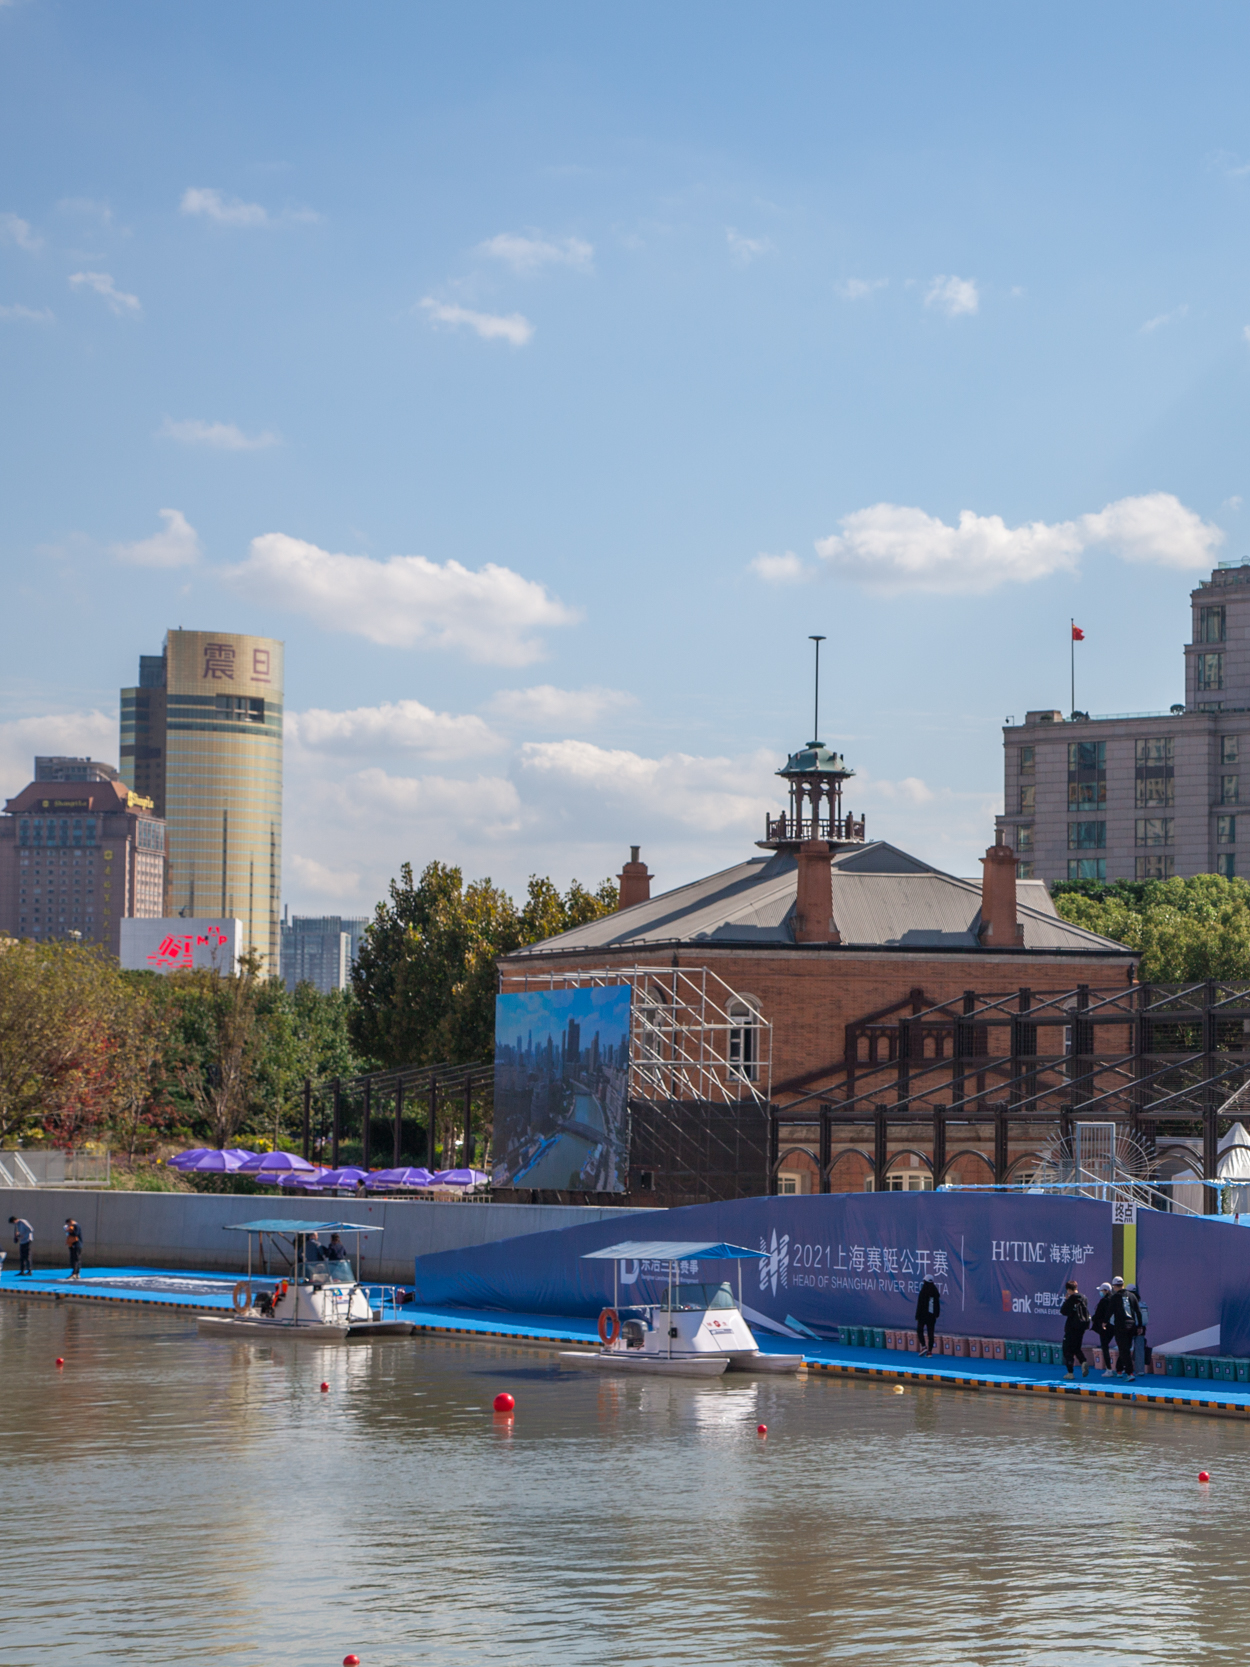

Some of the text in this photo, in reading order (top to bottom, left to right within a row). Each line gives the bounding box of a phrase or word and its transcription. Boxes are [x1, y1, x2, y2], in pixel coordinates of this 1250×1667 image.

[202, 642, 271, 683] 震旦
[1115, 1202, 1133, 1223] 终点
[793, 1243, 949, 1277] 2021上海赛艇公开赛
[1049, 1243, 1094, 1264] 海泰地产
[793, 1274, 815, 1287] HEAD
[817, 1275, 829, 1288] OF
[831, 1276, 876, 1290] SHANGHAI
[878, 1279, 905, 1293] RIVER
